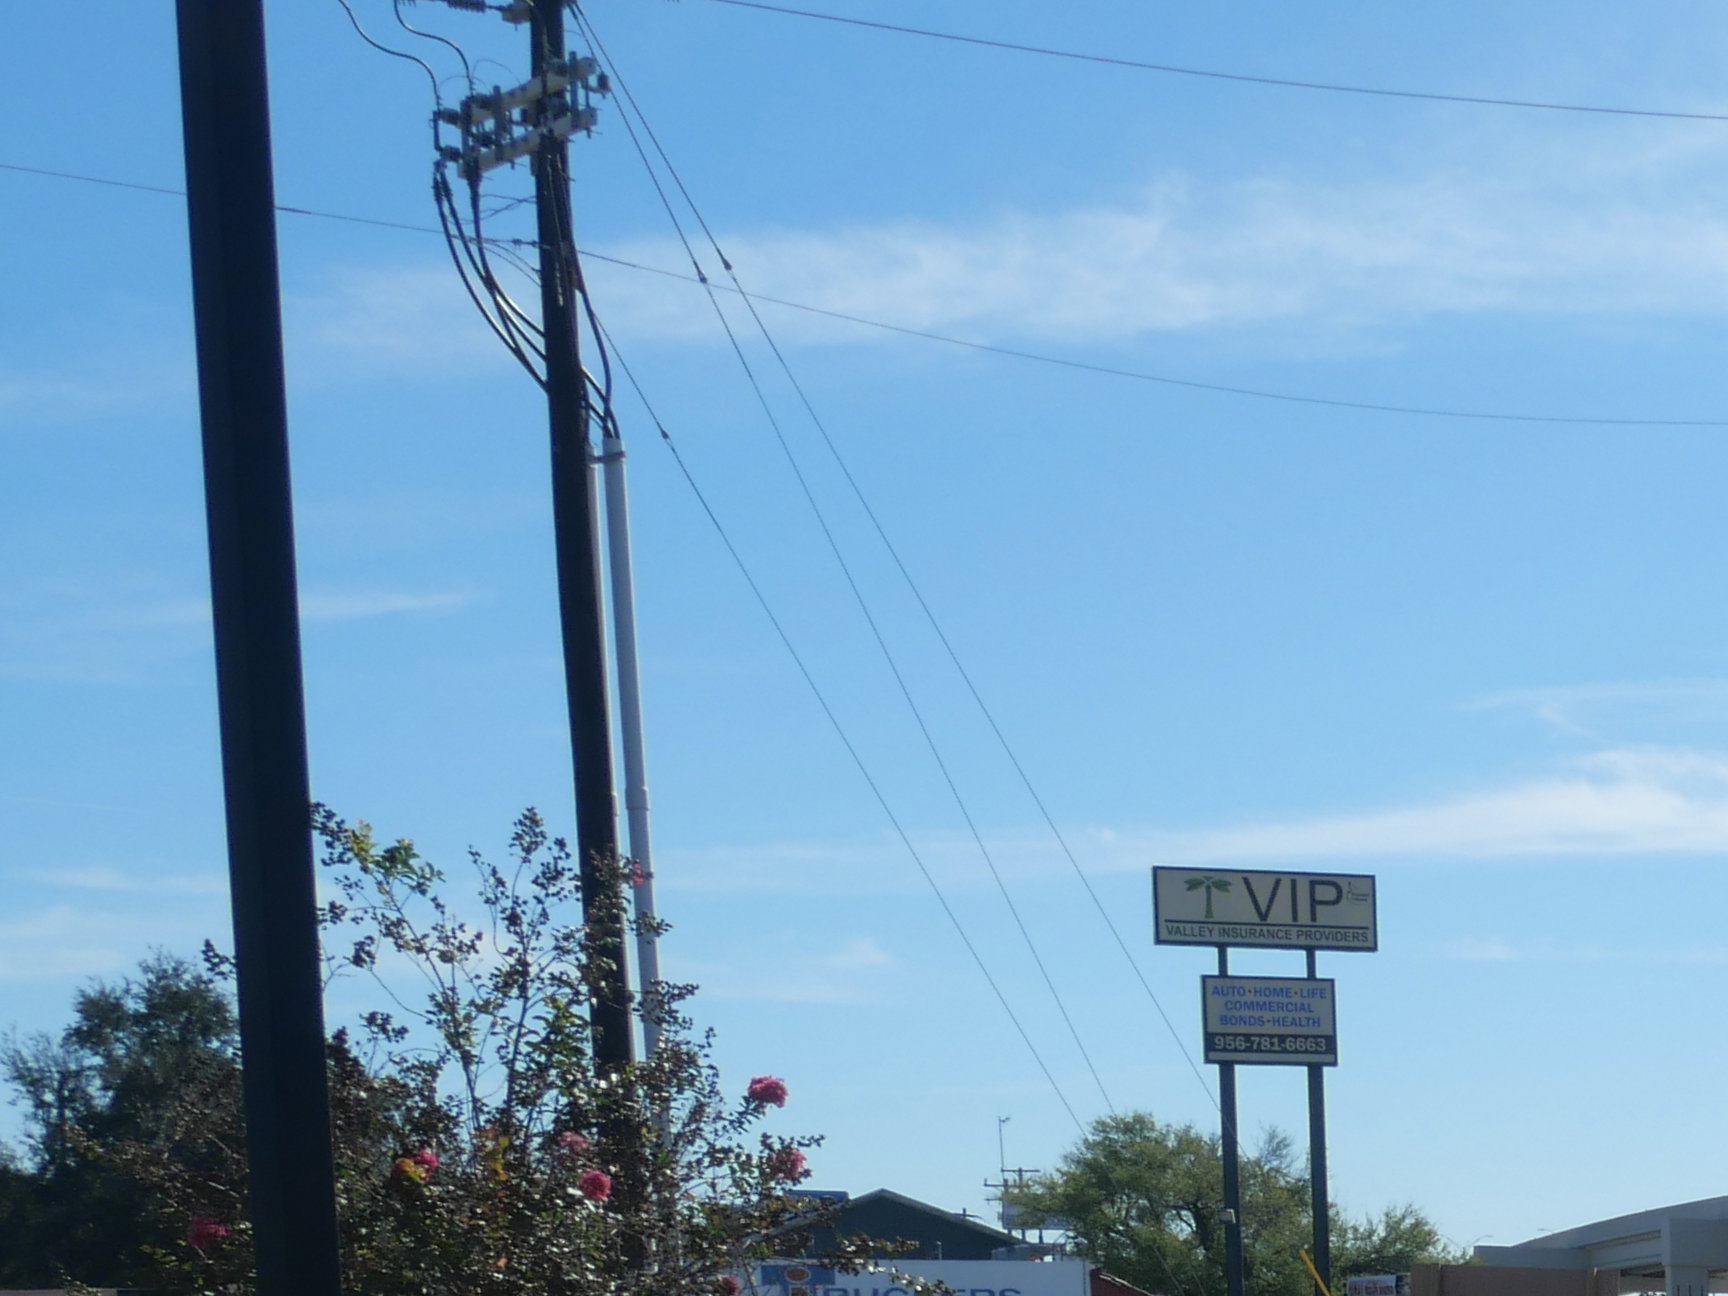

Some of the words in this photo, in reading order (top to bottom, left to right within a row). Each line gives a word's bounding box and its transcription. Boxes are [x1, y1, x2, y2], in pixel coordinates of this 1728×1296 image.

[1242, 876, 1343, 923] VIP
[1167, 924, 1216, 938] VALLEY
[1218, 926, 1293, 941] INSURANCE
[1296, 930, 1369, 943] PROVIDERS
[1211, 985, 1246, 997] AUTO
[1253, 986, 1292, 998] HOME
[1300, 987, 1327, 999] LIFE
[1224, 1000, 1314, 1014] COMMERCIAL
[1219, 1015, 1265, 1027] BONDS
[1272, 1016, 1321, 1028] HEALTH
[1214, 1036, 1326, 1052] 956-781-6663
